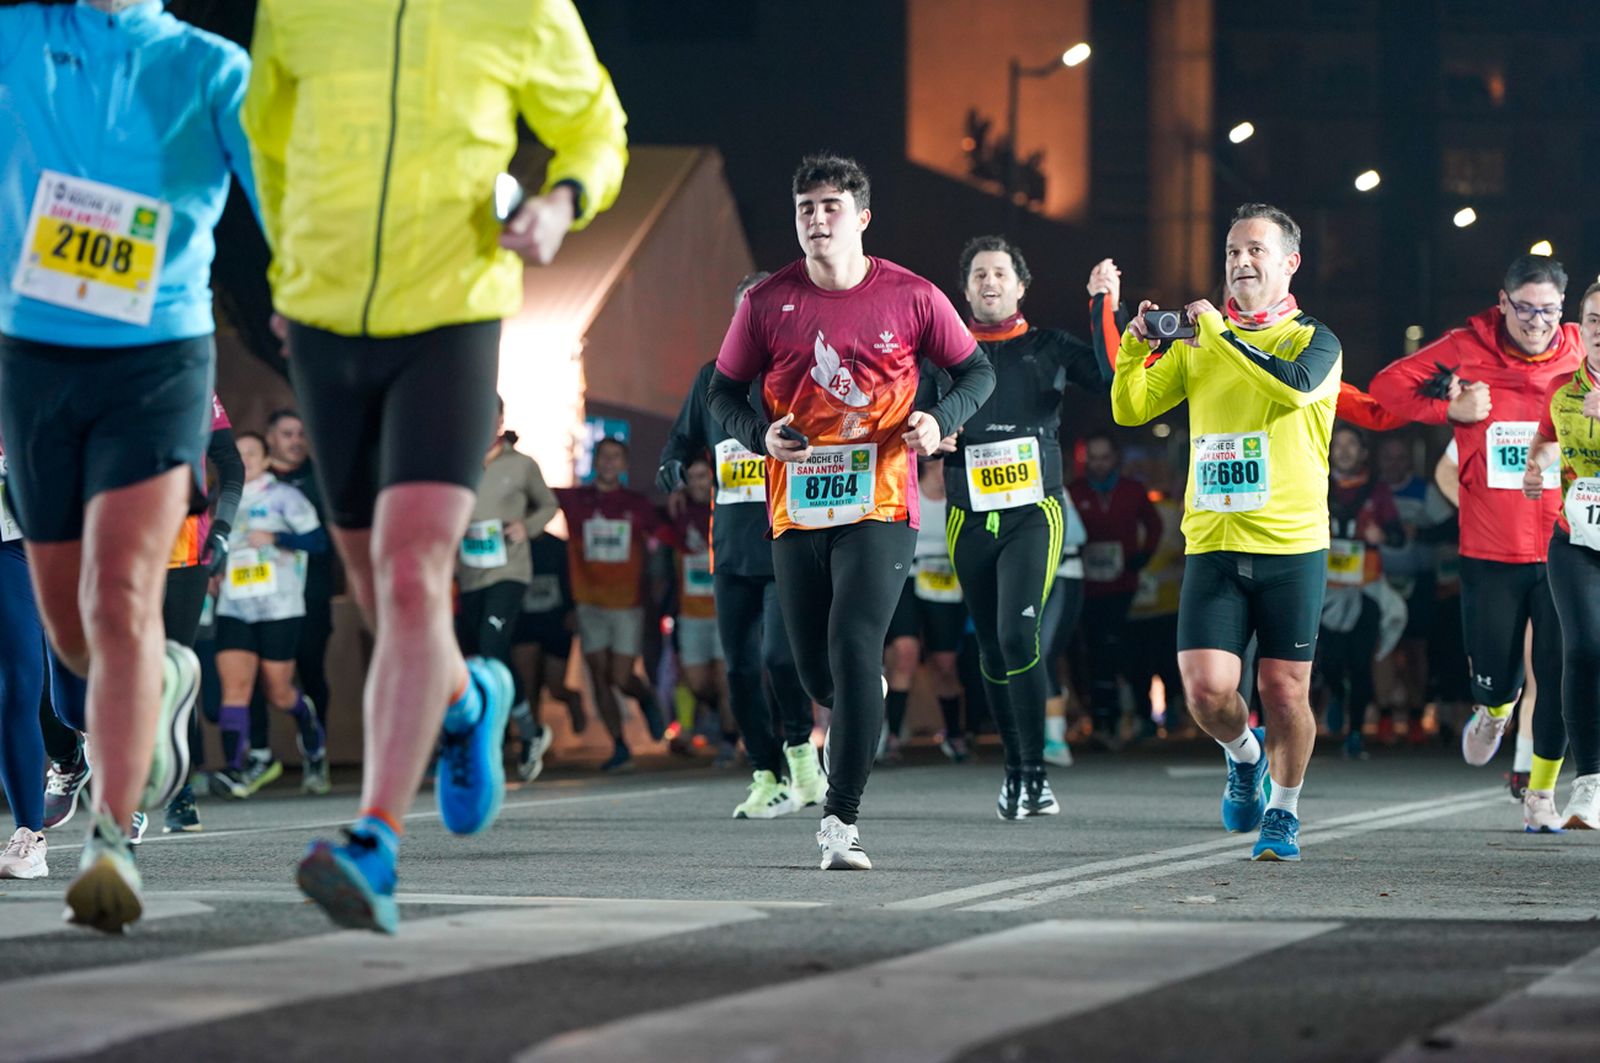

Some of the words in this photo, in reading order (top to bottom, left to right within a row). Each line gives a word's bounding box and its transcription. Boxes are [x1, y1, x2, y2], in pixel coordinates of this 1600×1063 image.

[52, 223, 133, 275] 2108
[829, 374, 851, 396] 43
[1226, 442, 1235, 450] DE
[806, 455, 832, 464] NOCHE
[833, 454, 844, 463] DE
[796, 466, 815, 475] SAN
[981, 462, 1029, 487] 8669
[1200, 460, 1260, 486] 12680
[805, 473, 858, 499] 8764
[1575, 492, 1592, 501] SAN
